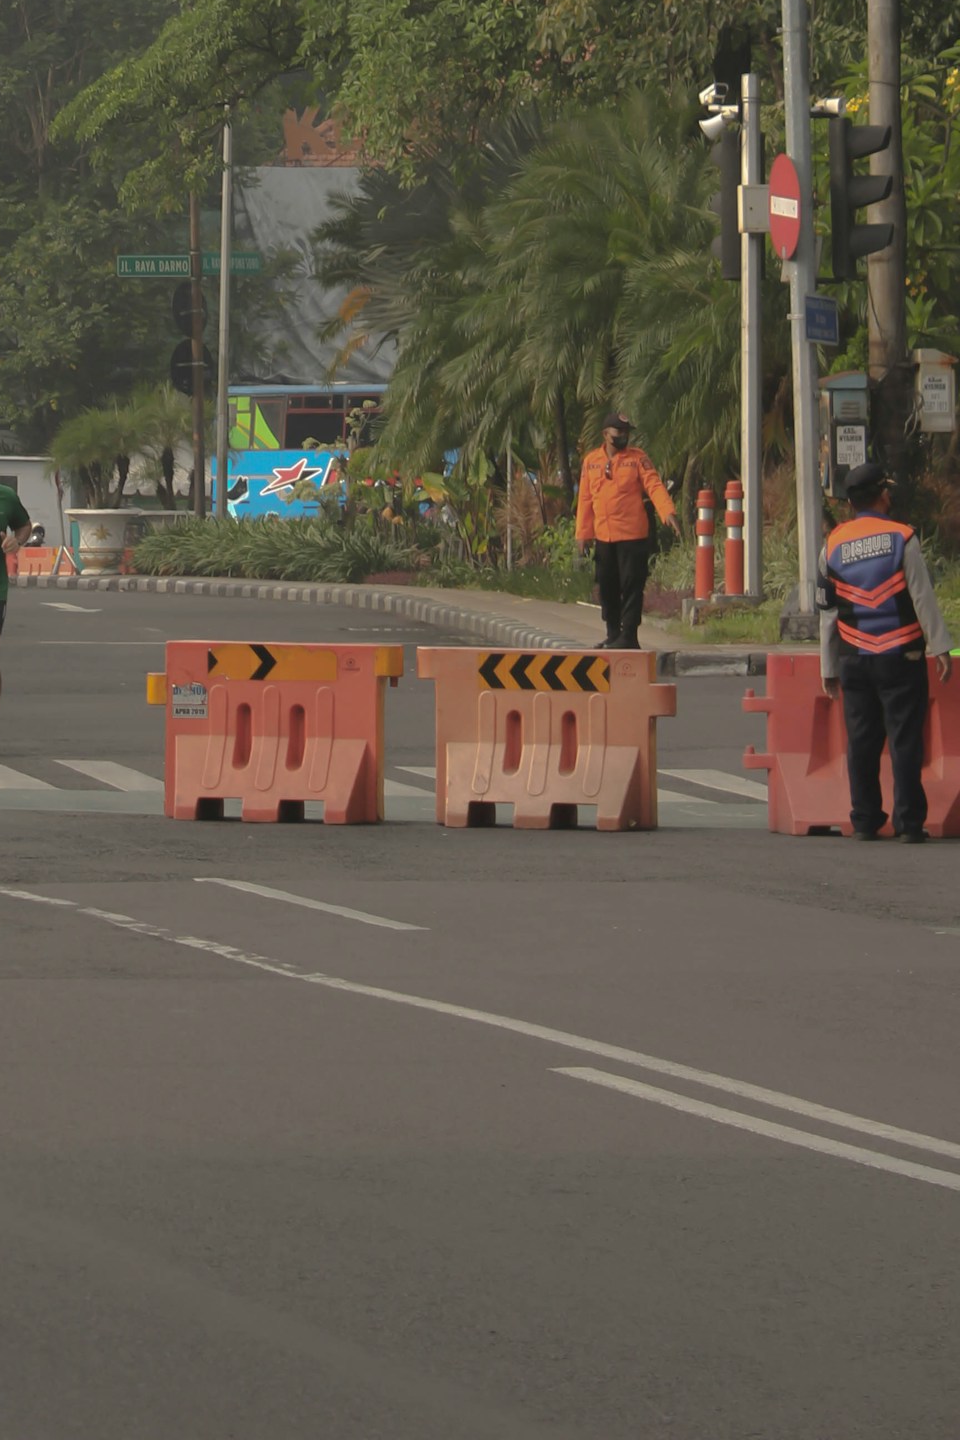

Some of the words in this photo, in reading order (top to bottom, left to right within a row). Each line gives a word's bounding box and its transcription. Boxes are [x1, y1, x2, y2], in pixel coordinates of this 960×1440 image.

[121, 260, 132, 272] JL.
[135, 260, 156, 272] RAYA
[159, 260, 188, 272] DARMO
[841, 533, 892, 560] DISHUB
